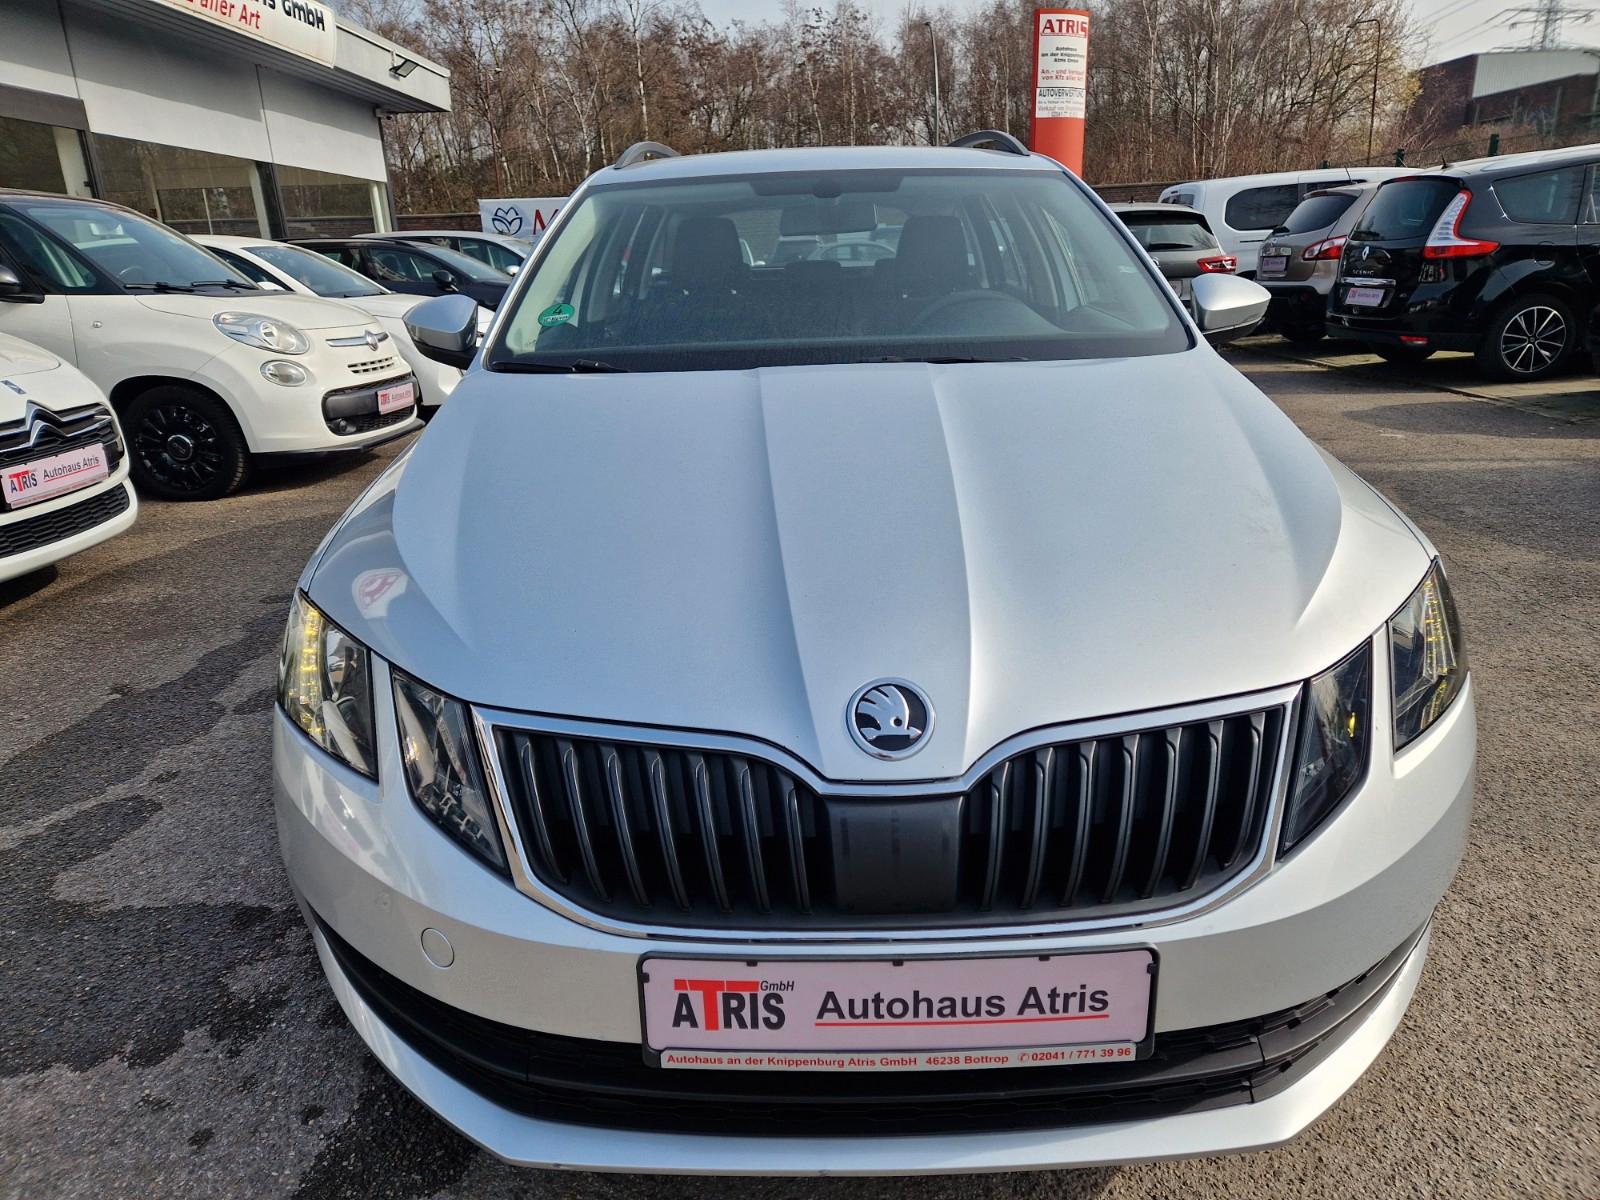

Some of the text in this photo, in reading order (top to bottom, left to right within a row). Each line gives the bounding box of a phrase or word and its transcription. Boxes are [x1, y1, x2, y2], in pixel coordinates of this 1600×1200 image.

[239, 4, 260, 29] Art
[553, 304, 562, 314] 4
[8, 470, 38, 494] ATRIS
[43, 462, 81, 480] Autohaus
[82, 455, 100, 468] Atris
[672, 979, 795, 1031] ATRIS GmbH
[816, 984, 1109, 1020] Autohaus Atris
[667, 1055, 723, 1065] Autohaus
[727, 1057, 741, 1065] an
[745, 1057, 764, 1065] der
[767, 1057, 845, 1068] Knippenburg
[848, 1057, 876, 1067] Atris
[880, 1057, 917, 1066] GmbH
[926, 1057, 960, 1065] 46238
[964, 1055, 1009, 1066] Bottrop
[1032, 1051, 1065, 1062] 02041
[1077, 1050, 1096, 1059] 771
[1100, 1048, 1115, 1058] 39
[1117, 1047, 1131, 1057] 96
